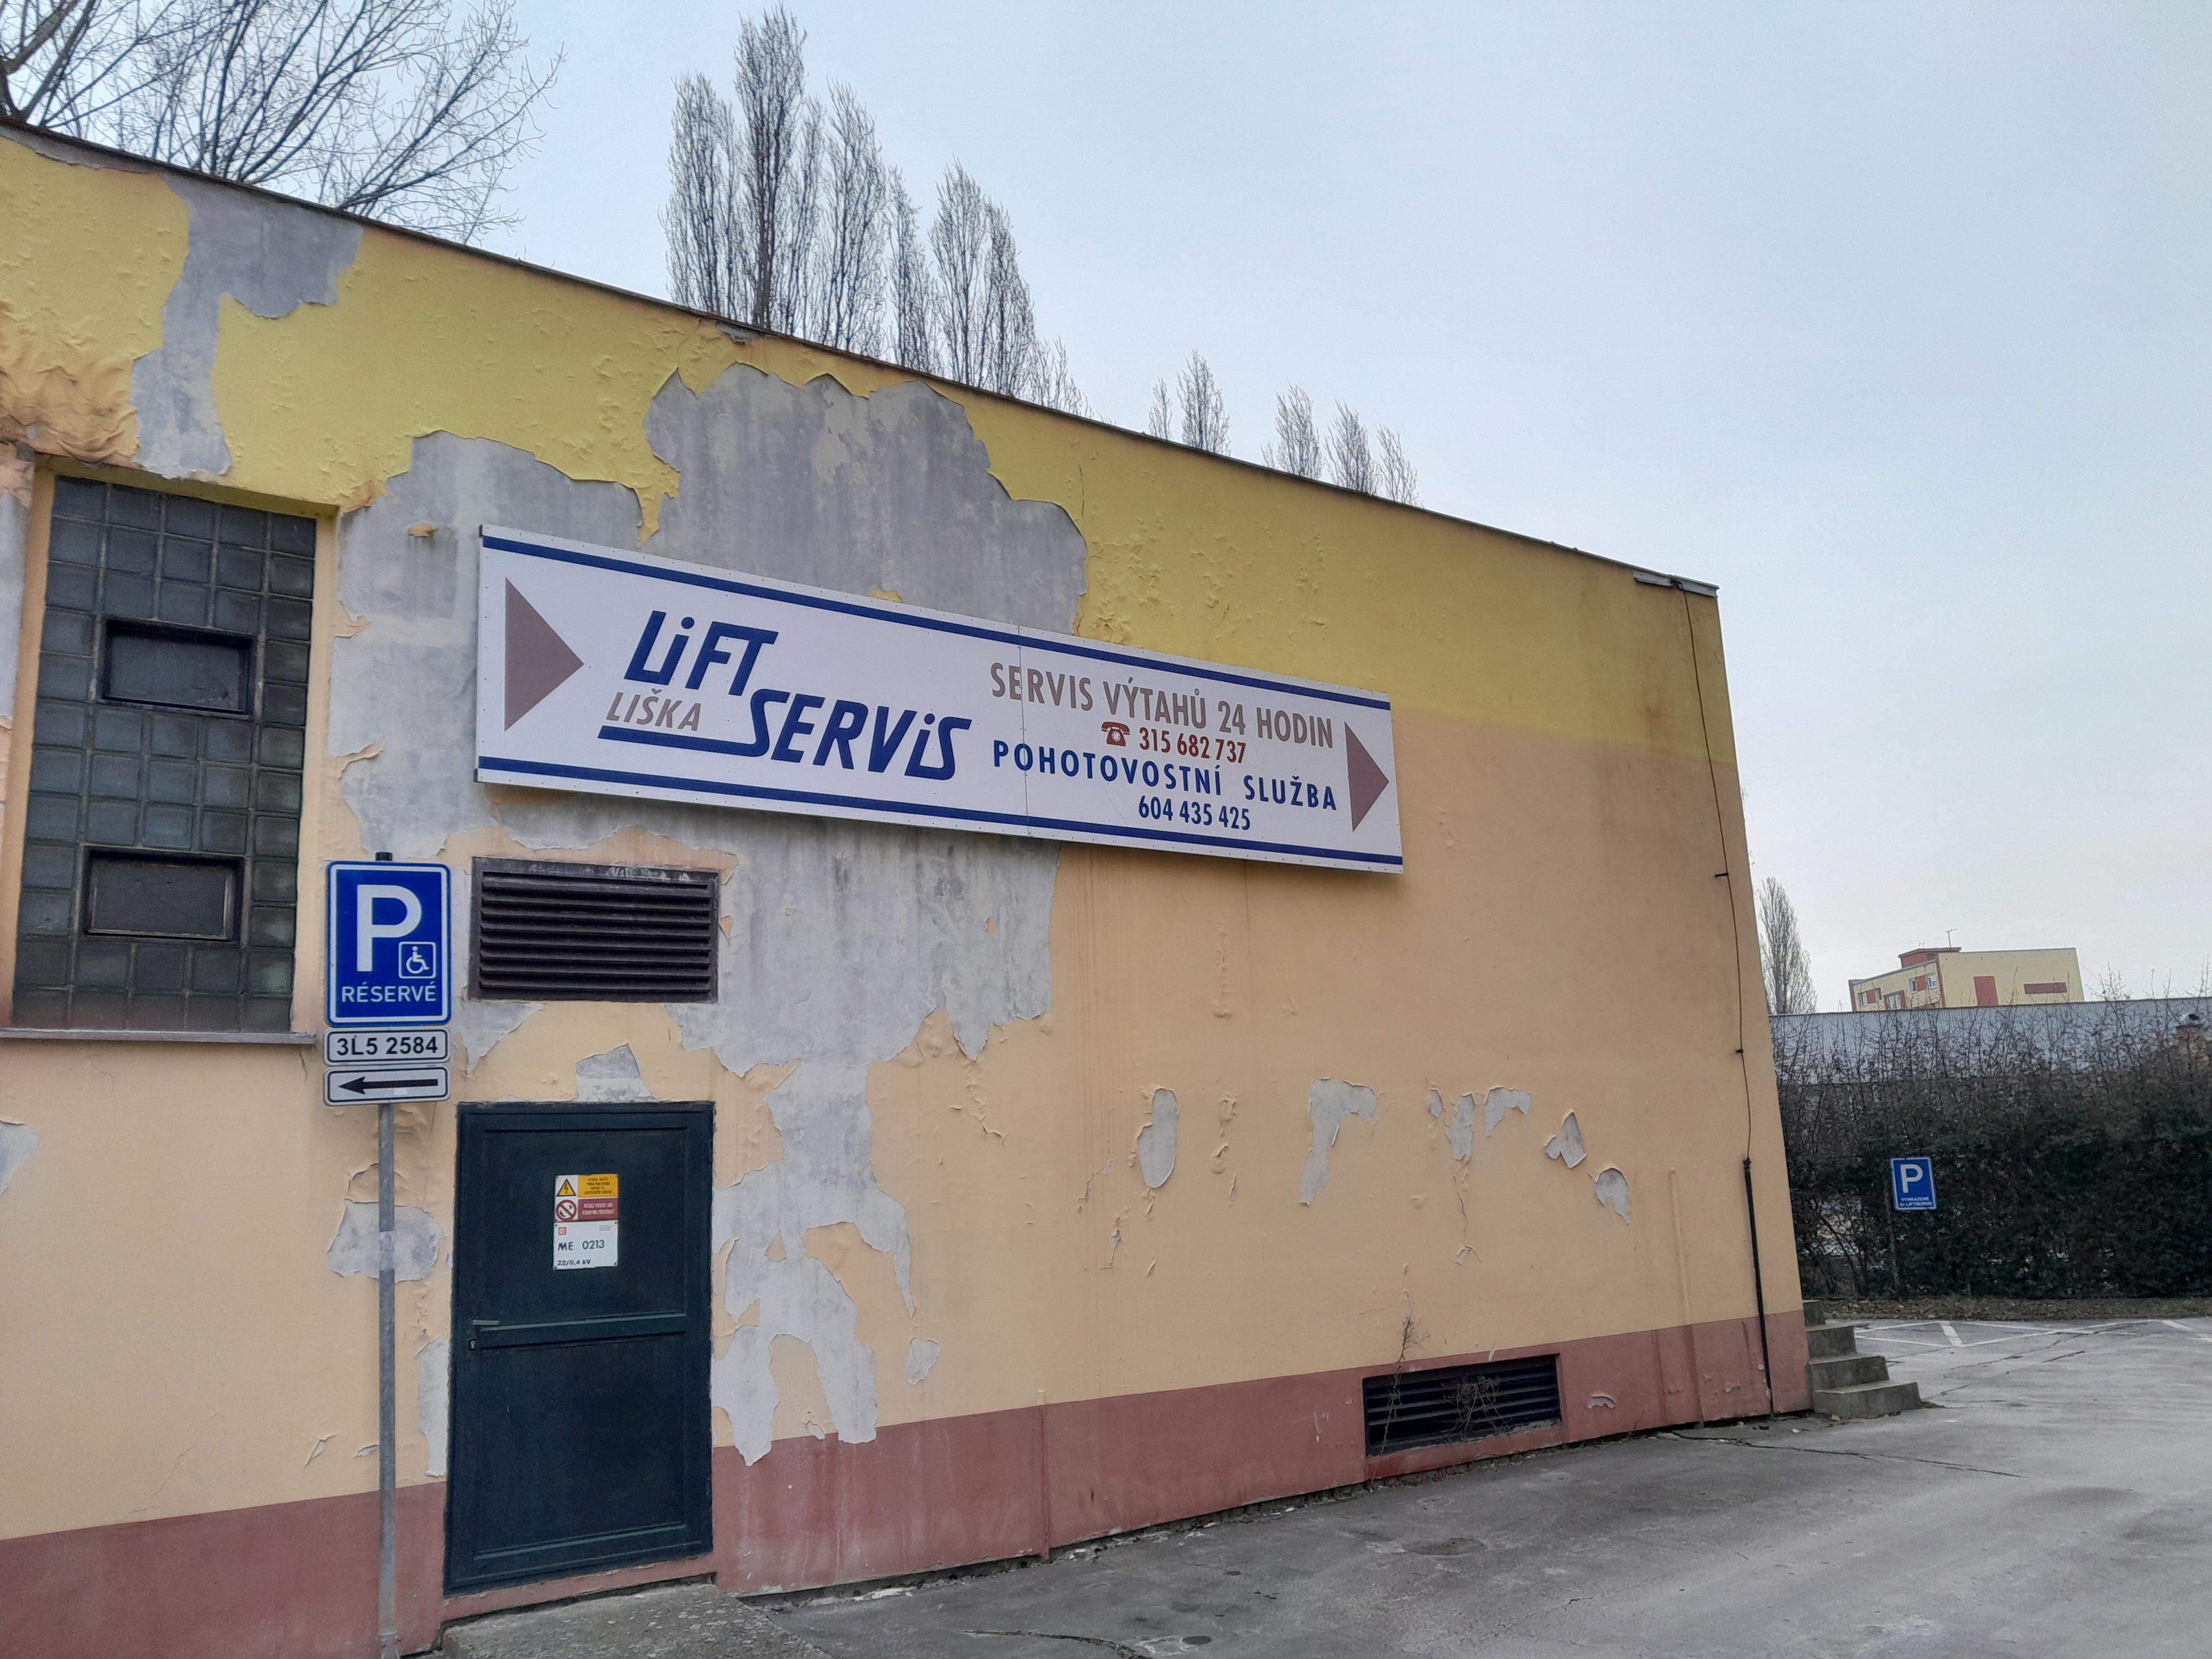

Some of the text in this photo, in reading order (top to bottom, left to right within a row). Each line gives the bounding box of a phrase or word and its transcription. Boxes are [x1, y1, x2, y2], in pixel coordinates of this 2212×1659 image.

[606, 688, 702, 732] LIŠKA
[990, 662, 1333, 749] SERVIS VÝTAHŮ 24 HODIN
[1139, 727, 1246, 764] 315 682 737
[994, 739, 1337, 811] POHOTOVOSTNÍ SLUŽBA
[1138, 796, 1250, 831] 604 435 425
[356, 884, 422, 972] P
[341, 981, 437, 1003] RÉSERVÉ
[336, 1036, 438, 1056] 3L5 2584
[1900, 1164, 1923, 1193] P
[557, 1239, 605, 1251] ME 0213
